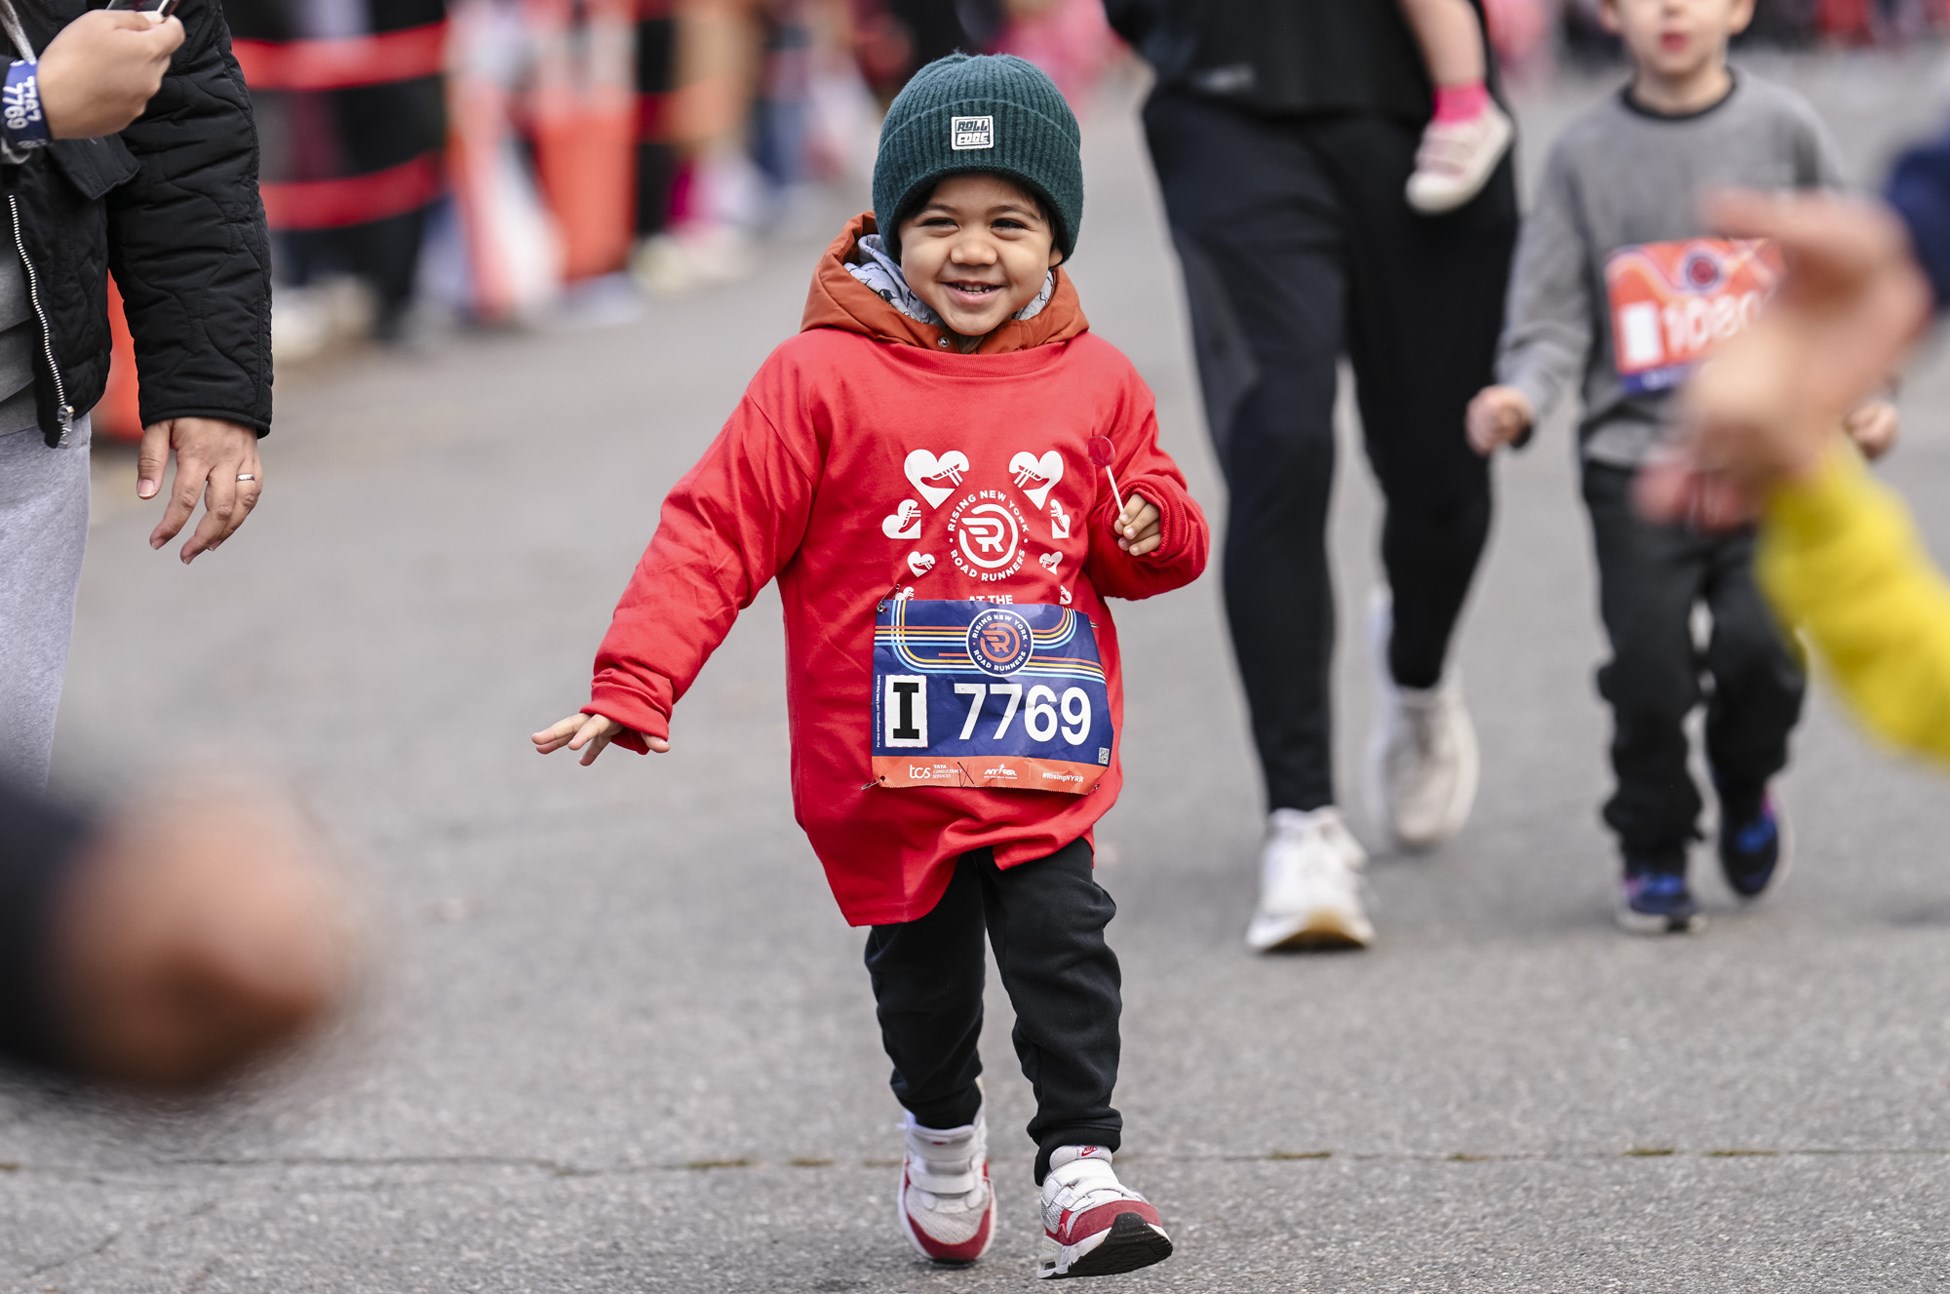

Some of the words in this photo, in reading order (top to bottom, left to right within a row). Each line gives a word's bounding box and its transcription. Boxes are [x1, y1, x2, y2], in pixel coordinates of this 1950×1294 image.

[3, 82, 29, 129] 7769
[957, 120, 988, 132] ROLL
[947, 494, 977, 533] RISING
[979, 489, 1006, 503] NEW
[1007, 499, 1030, 533] YORK
[949, 549, 978, 578] ROAD
[981, 549, 1026, 582] RUNNERS
[987, 594, 1014, 605] THE
[972, 615, 993, 639] RISING
[1014, 619, 1029, 641] YORK
[973, 649, 992, 669] ROAD
[993, 650, 1027, 672] RUNNERS
[893, 682, 920, 739] I
[954, 683, 1092, 745] 7769
[909, 764, 931, 779] tcs
